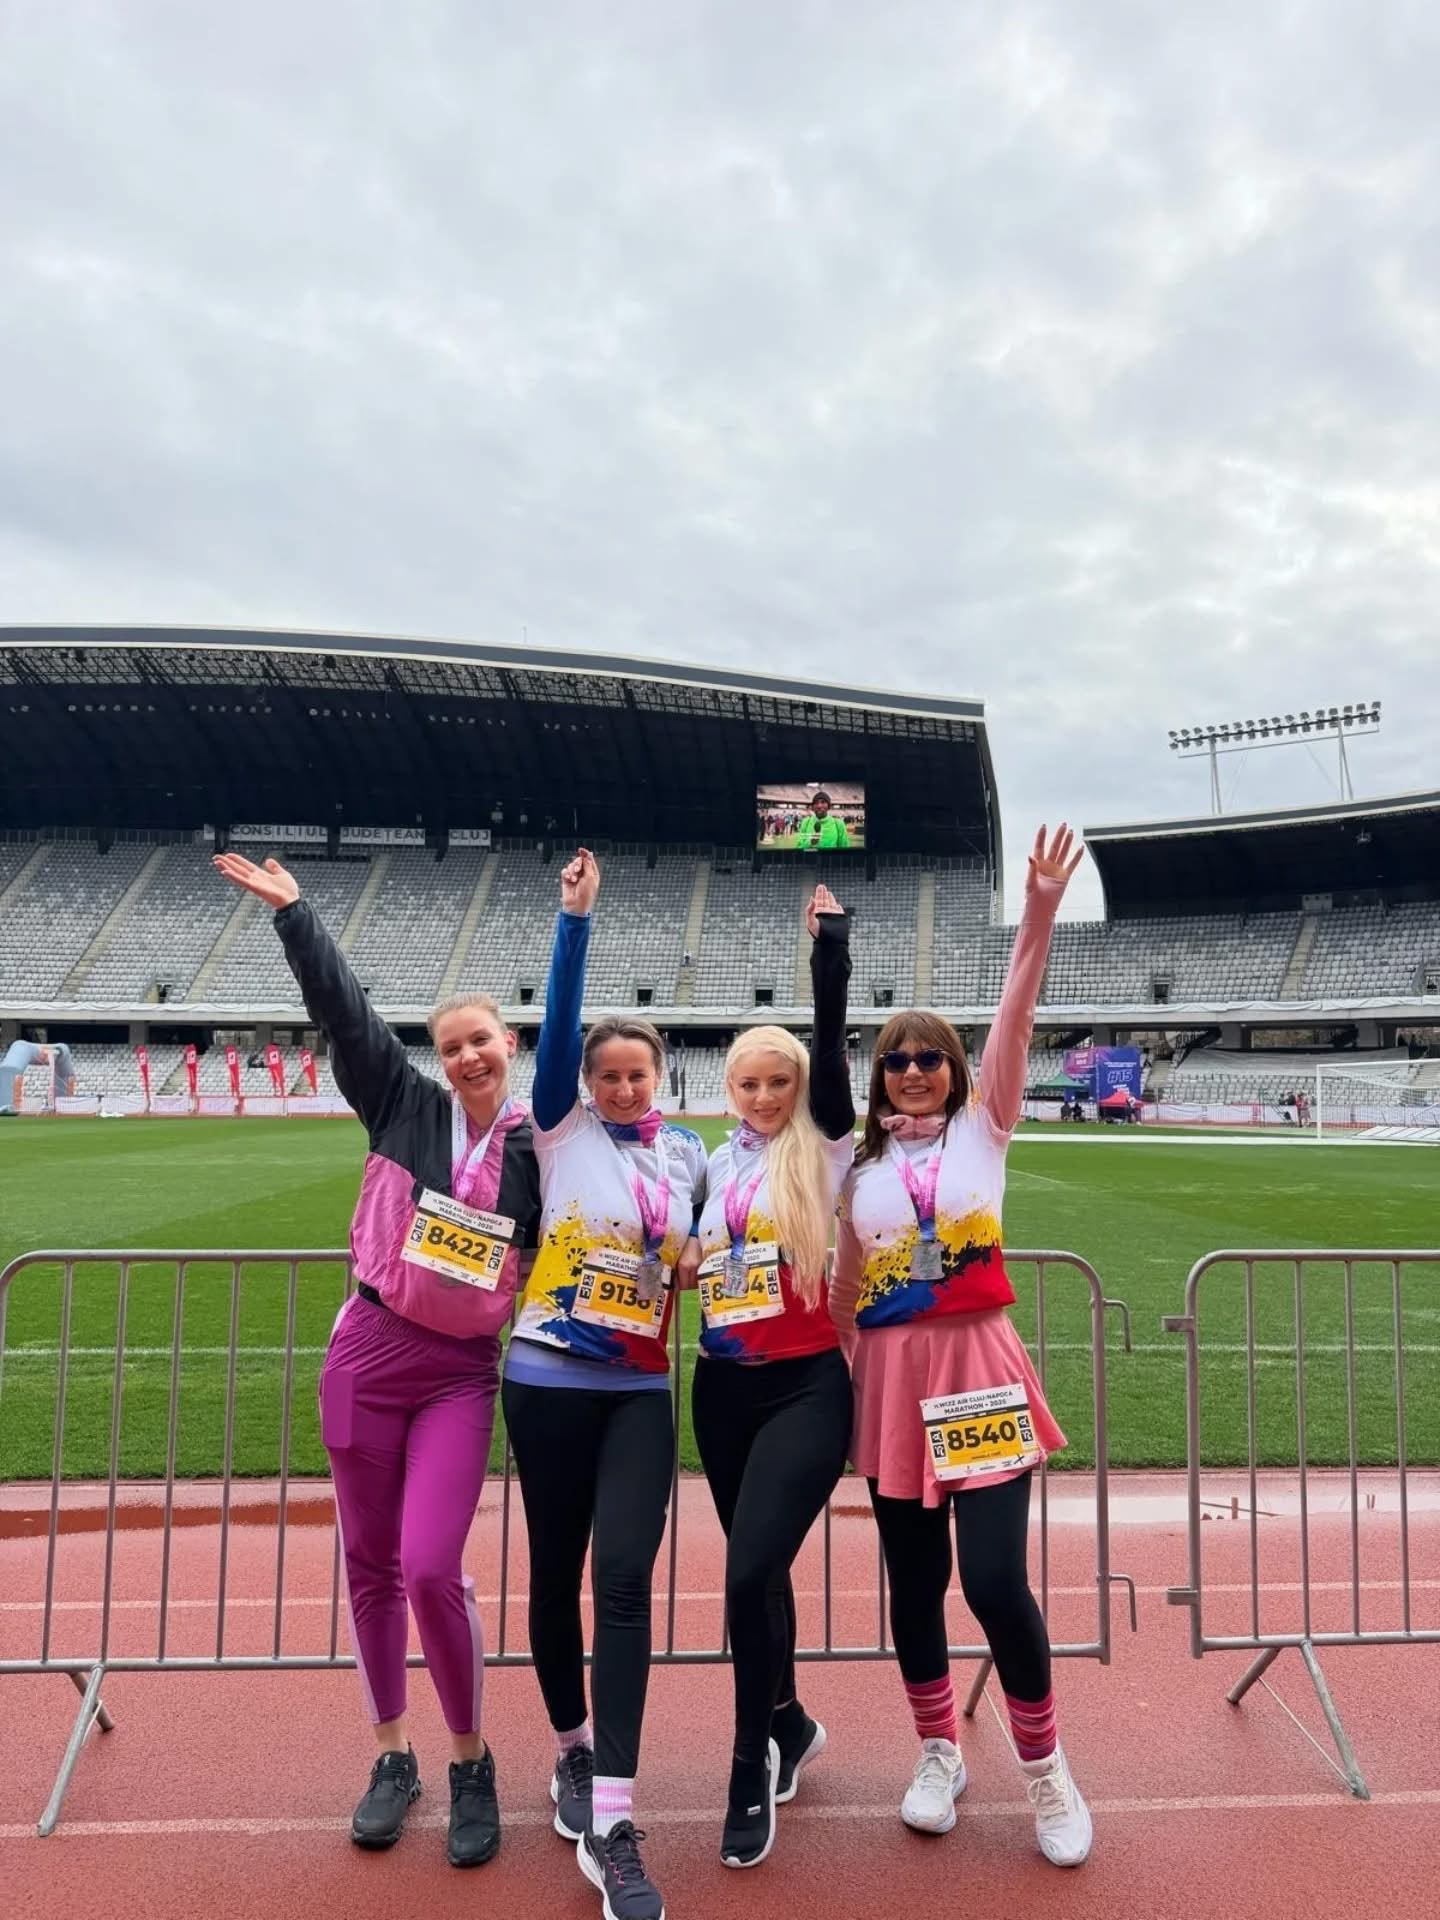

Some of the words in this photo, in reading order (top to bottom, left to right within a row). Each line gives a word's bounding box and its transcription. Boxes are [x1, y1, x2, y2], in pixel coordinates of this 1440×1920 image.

[230, 825, 327, 837] CONSILIUL
[449, 829, 489, 841] CLUJ
[438, 1207, 473, 1224] MARATHON
[427, 1226, 488, 1262] 8422
[604, 1253, 619, 1262] WIZZ
[620, 1256, 631, 1264] AIR
[605, 1260, 639, 1272] MARATHO
[712, 1274, 765, 1301] 84
[939, 1400, 956, 1408] WIZZ
[944, 1403, 984, 1415] MARATHON
[947, 1420, 1017, 1451] 8540
